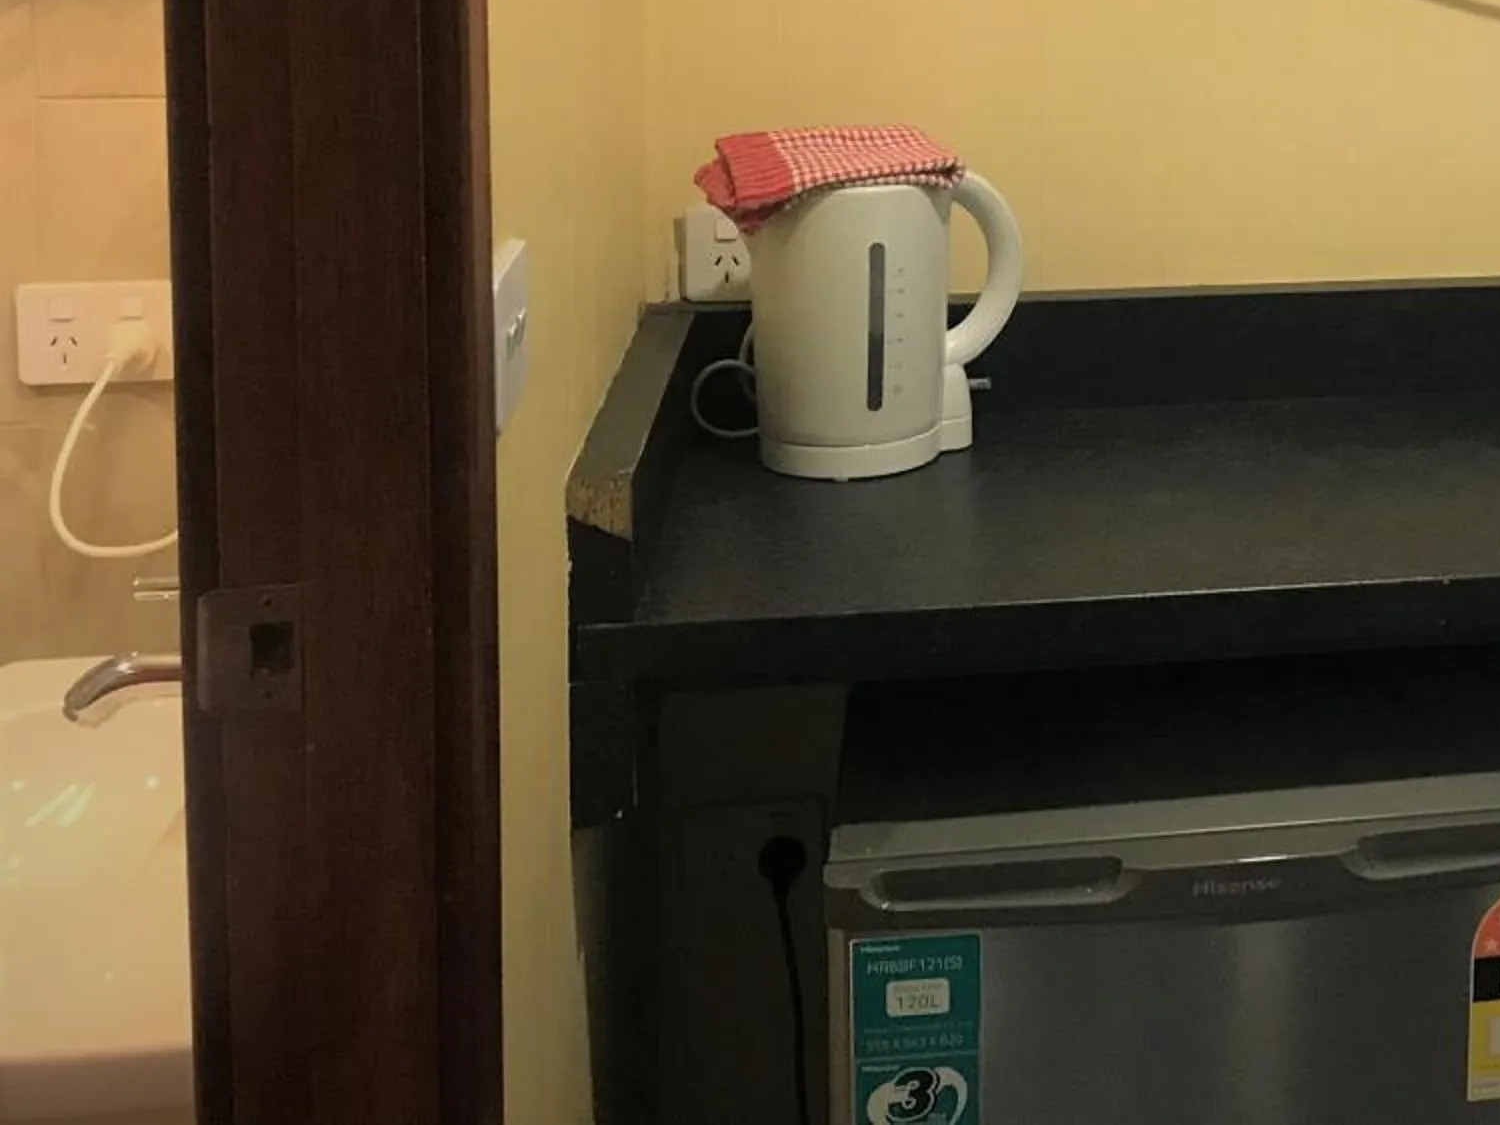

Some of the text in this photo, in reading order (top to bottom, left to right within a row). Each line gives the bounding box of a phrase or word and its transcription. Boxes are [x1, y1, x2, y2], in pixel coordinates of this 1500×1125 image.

[1192, 877, 1283, 898] Hisense
[896, 994, 939, 1012] 120L
[887, 1066, 939, 1122] 3
